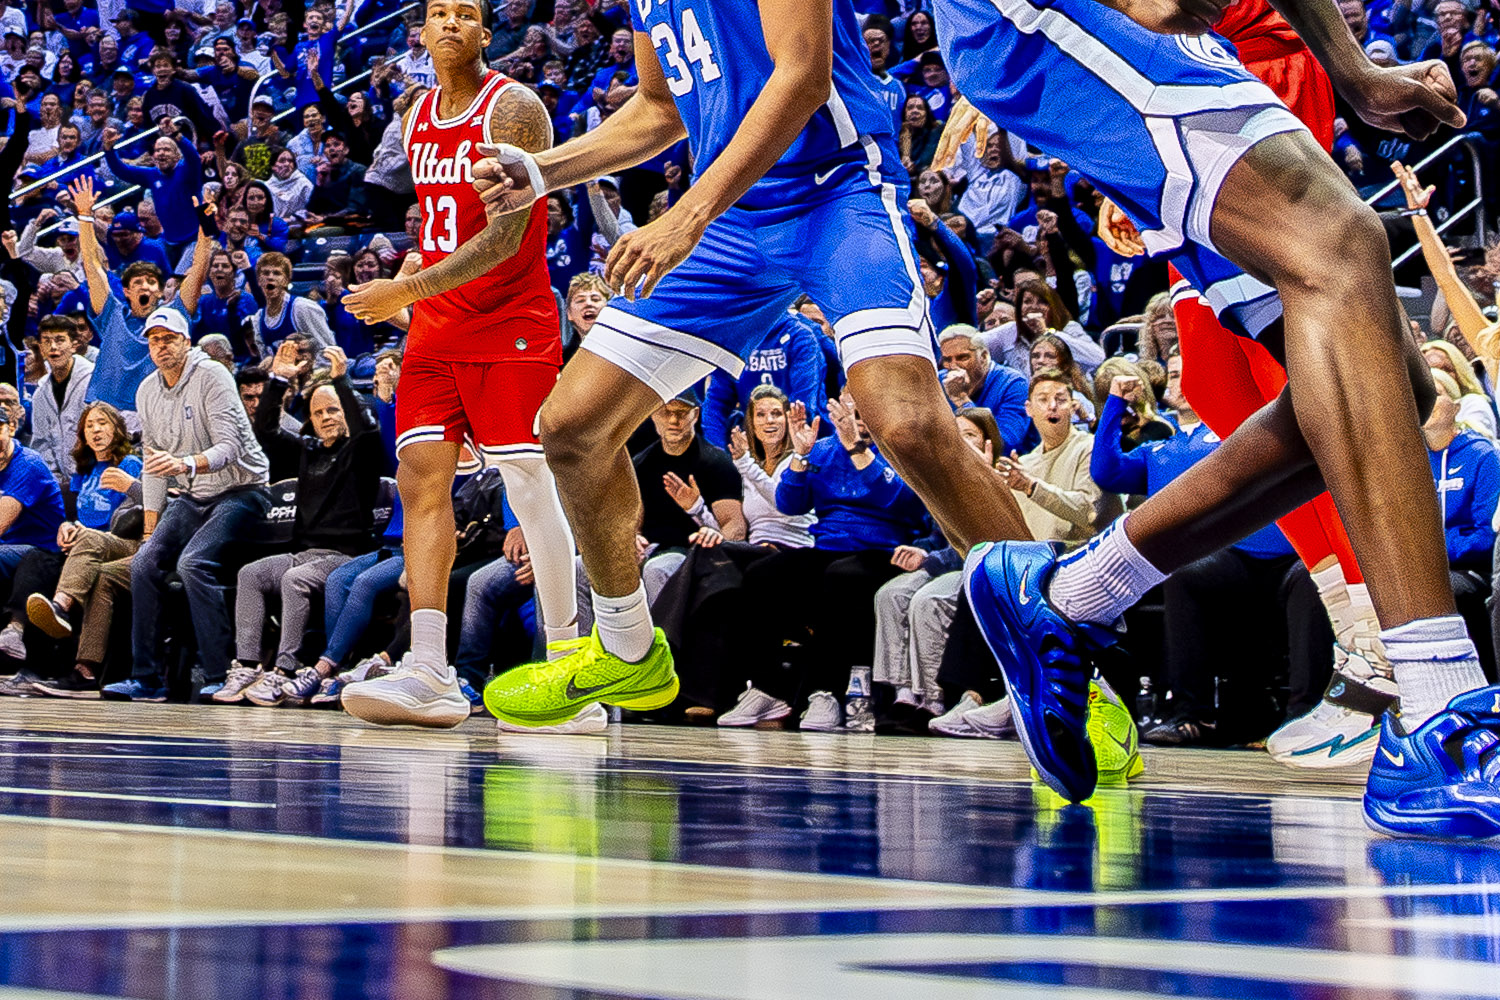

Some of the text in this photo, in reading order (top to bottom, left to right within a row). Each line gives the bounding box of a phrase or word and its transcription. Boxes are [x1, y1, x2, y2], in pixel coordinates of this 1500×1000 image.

[651, 7, 721, 97] 34
[411, 139, 475, 185] Utah
[423, 195, 457, 252] 13
